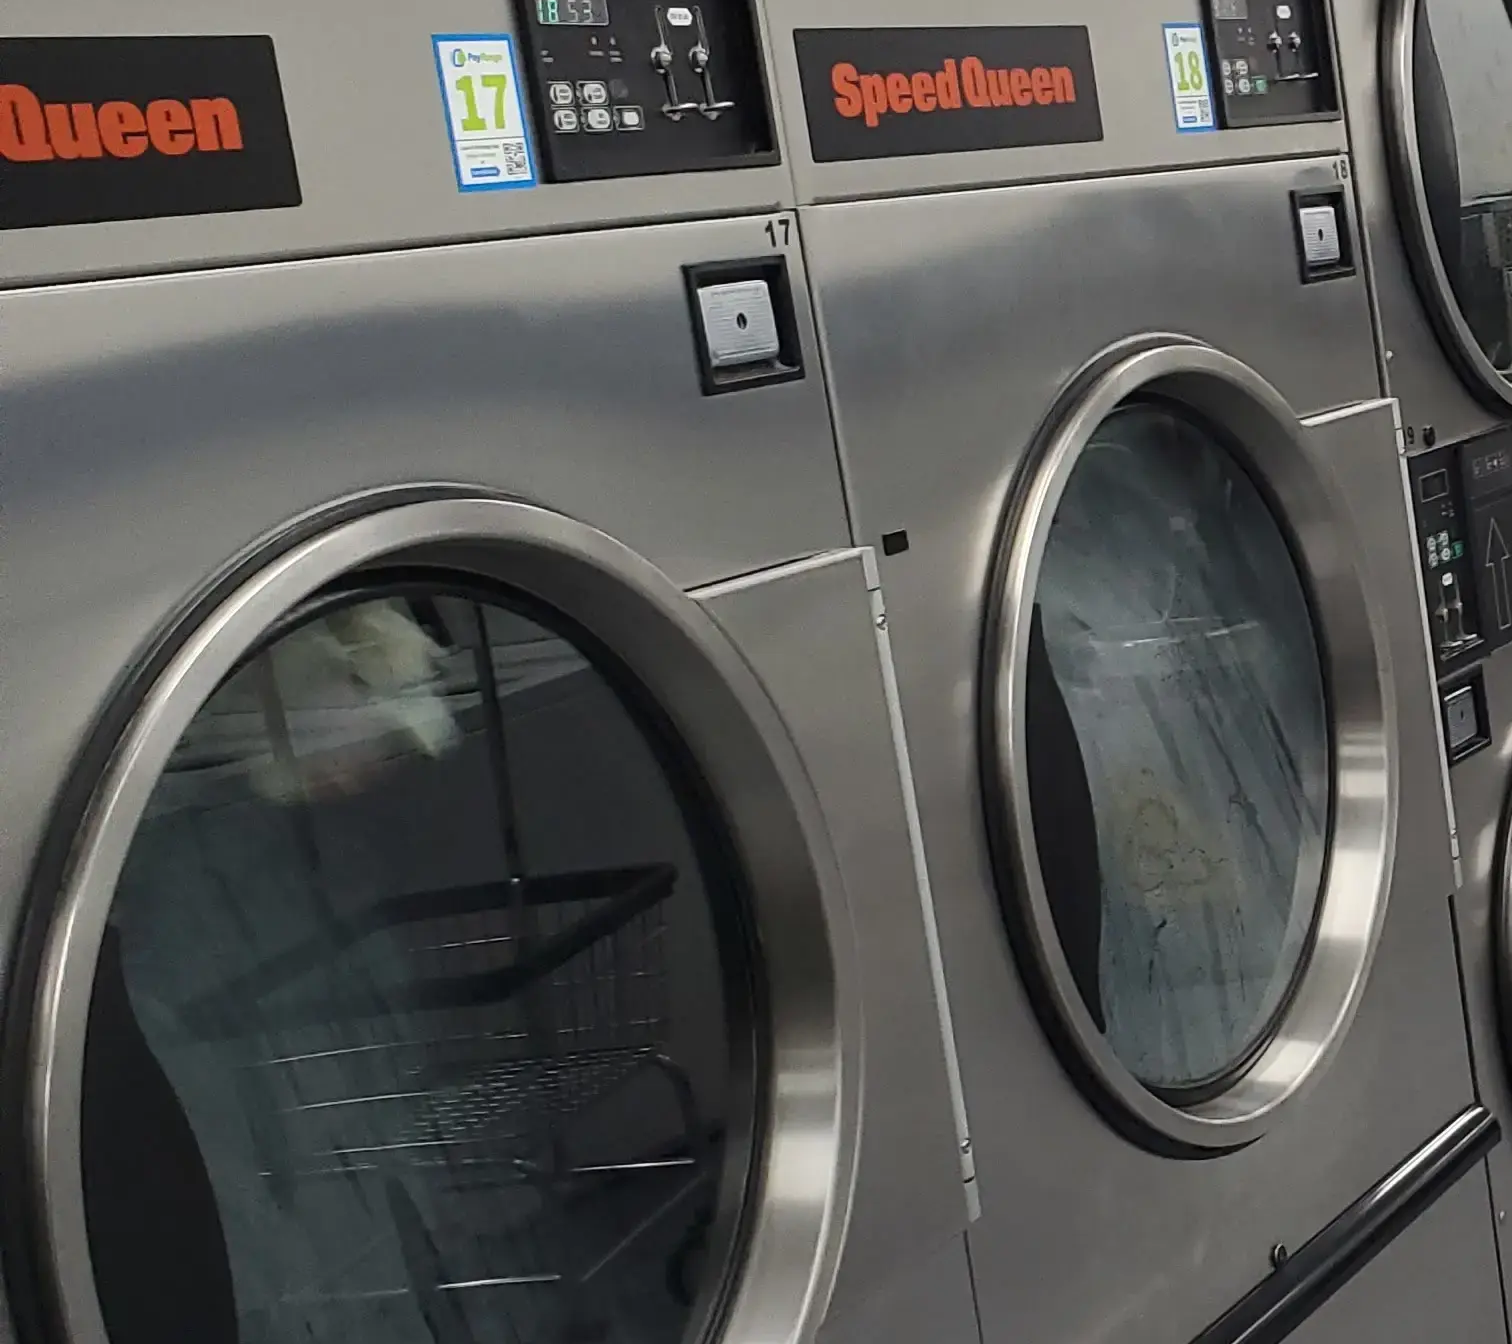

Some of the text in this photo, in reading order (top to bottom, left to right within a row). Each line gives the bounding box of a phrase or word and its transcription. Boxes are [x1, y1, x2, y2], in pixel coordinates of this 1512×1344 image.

[1174, 50, 1204, 92] 18
[0, 83, 244, 162] Queen
[455, 74, 507, 132] 17
[1332, 159, 1348, 180] 18
[765, 219, 790, 248] 17
